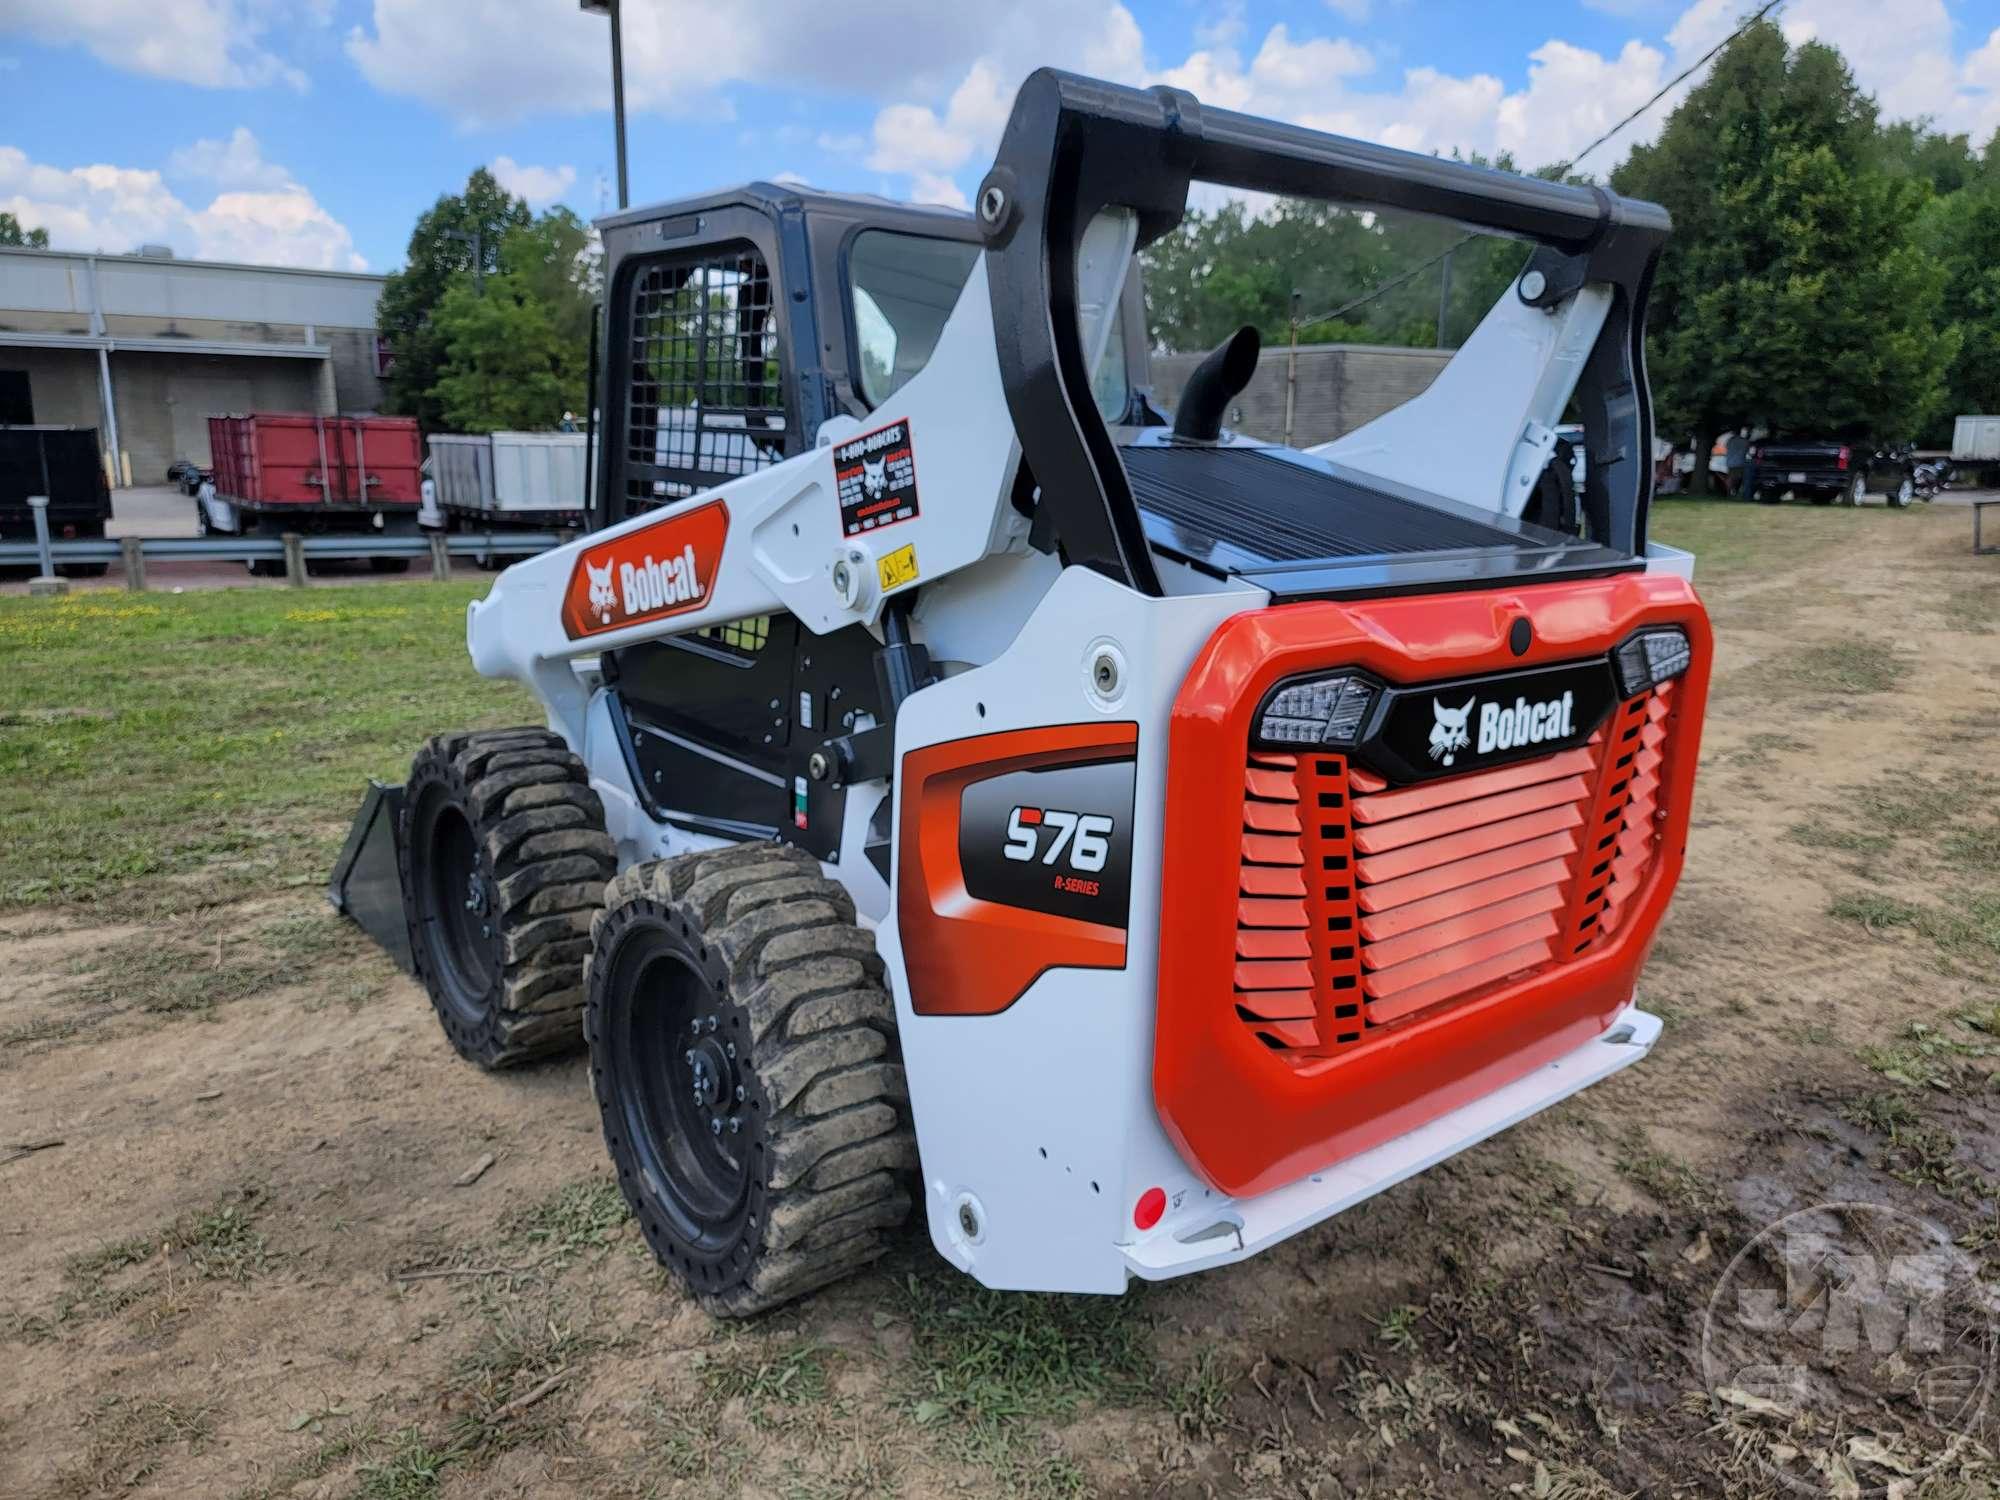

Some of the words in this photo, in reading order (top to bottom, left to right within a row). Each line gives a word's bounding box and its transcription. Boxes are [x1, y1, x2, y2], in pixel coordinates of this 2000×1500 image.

[619, 544, 700, 615] Bobcat
[1477, 690, 1573, 755] Bobcat
[1003, 806, 1113, 872] S76
[1054, 875, 1099, 896] R-SERIES
